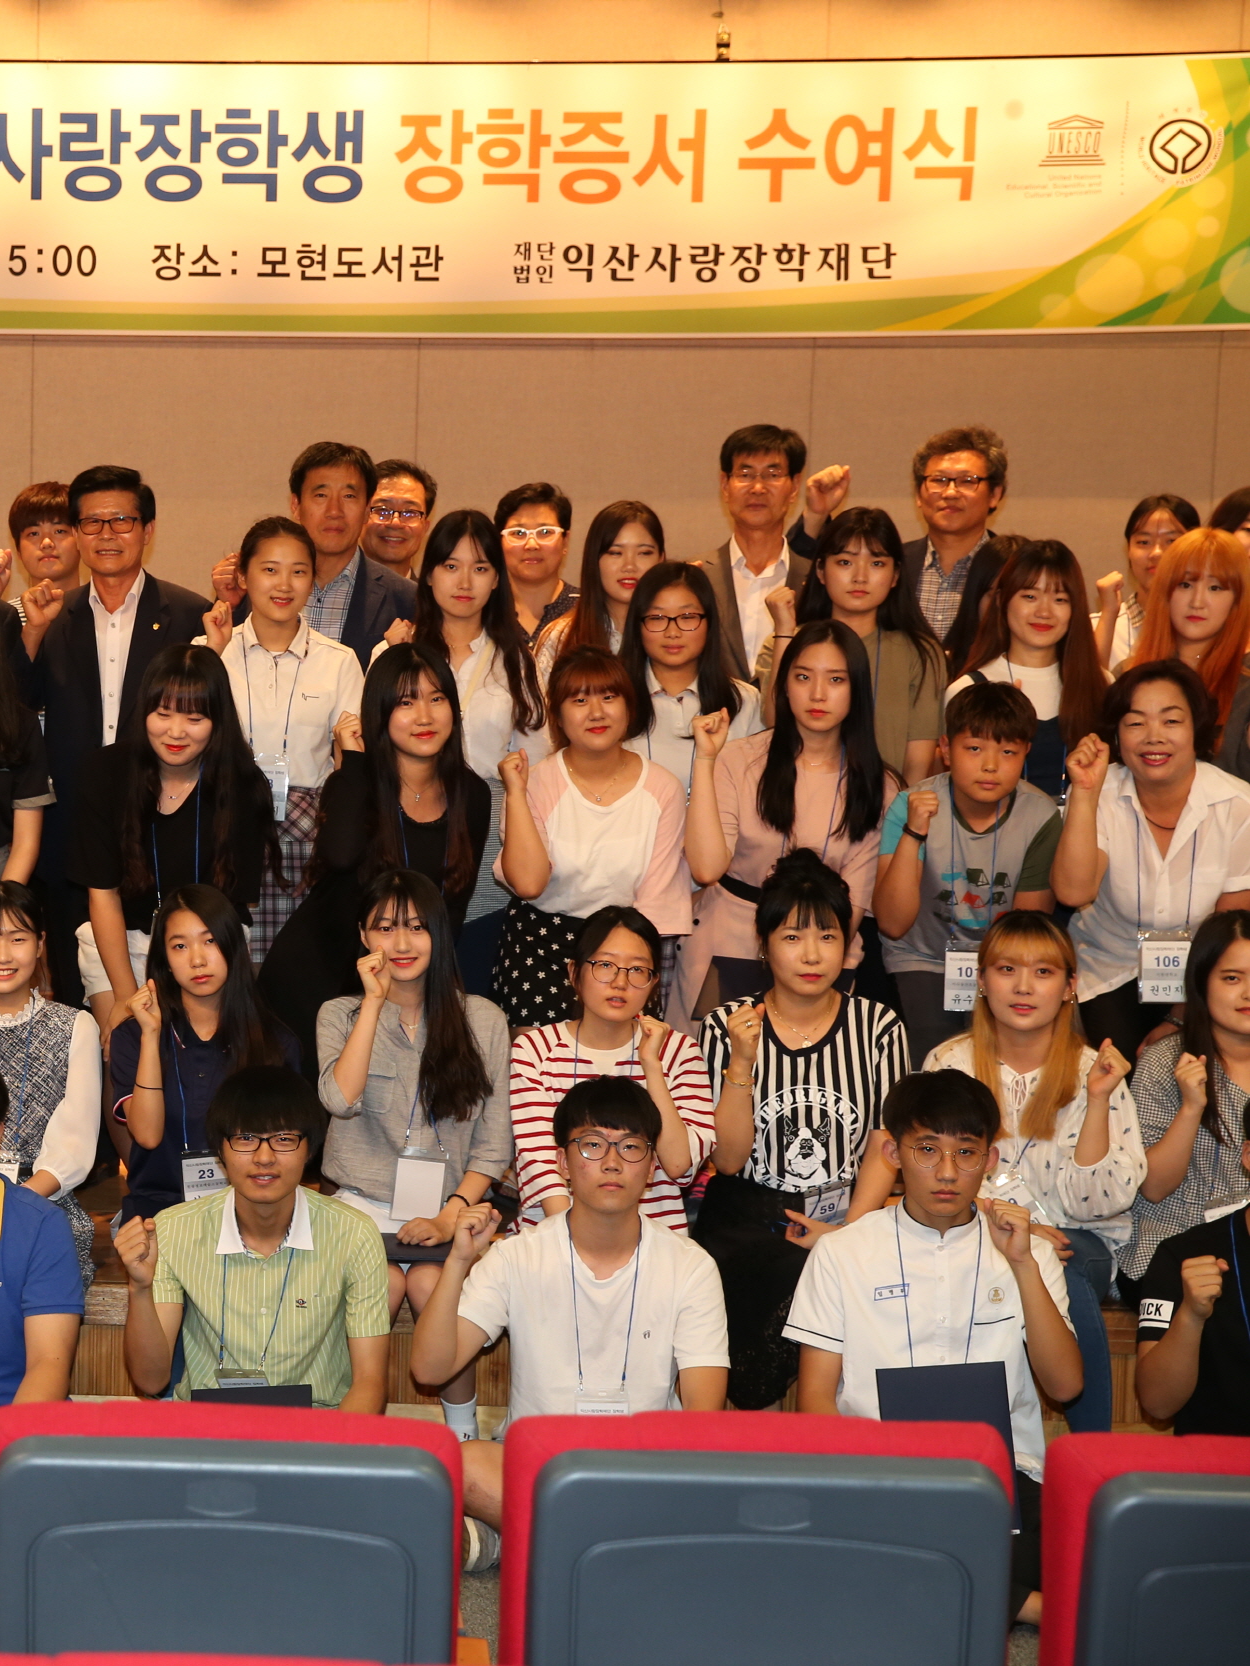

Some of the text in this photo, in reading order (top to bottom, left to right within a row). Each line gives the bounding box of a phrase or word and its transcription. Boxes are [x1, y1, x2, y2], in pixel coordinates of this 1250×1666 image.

[1047, 131, 1102, 154] UNESCO
[394, 108, 709, 205] 장학증서
[737, 106, 979, 204] 수여식
[513, 241, 556, 262] 재단
[150, 242, 445, 283] 장소: 모현도서관
[562, 241, 898, 284] 익산사랑장학재단
[513, 263, 555, 284] 법인
[956, 966, 979, 978] 10
[1154, 955, 1181, 968] 106
[197, 1168, 215, 1180] 23
[819, 1202, 836, 1215] 59
